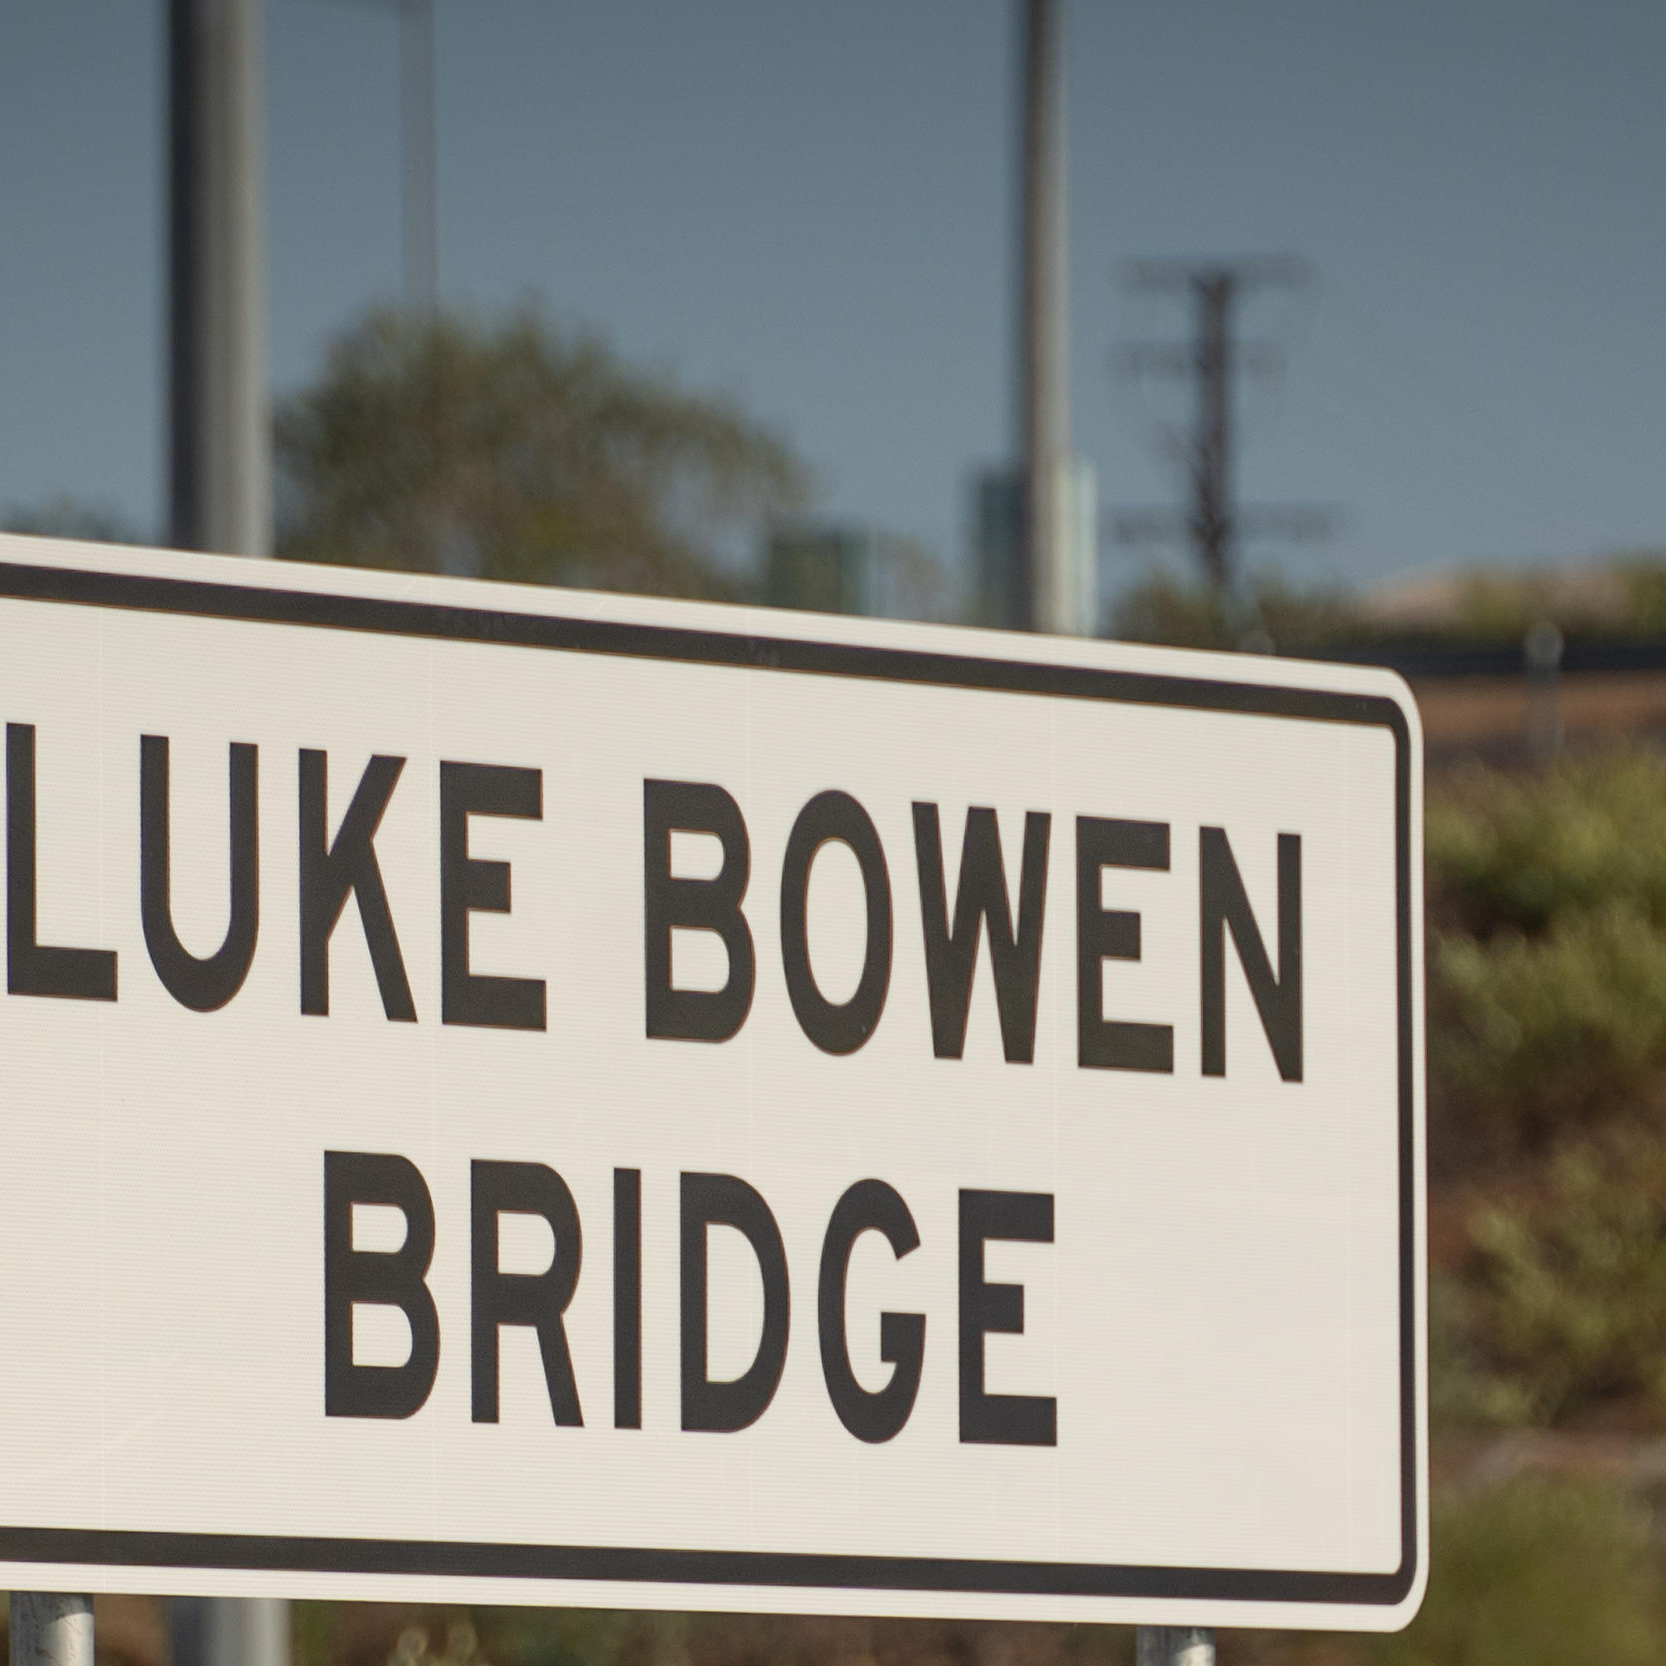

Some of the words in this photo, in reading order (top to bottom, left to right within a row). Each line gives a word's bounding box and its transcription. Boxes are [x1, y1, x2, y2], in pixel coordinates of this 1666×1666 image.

[5, 722, 548, 1032] LUKE
[643, 777, 1304, 1084] BOWEN
[323, 1149, 1058, 1447] BRIDGE
